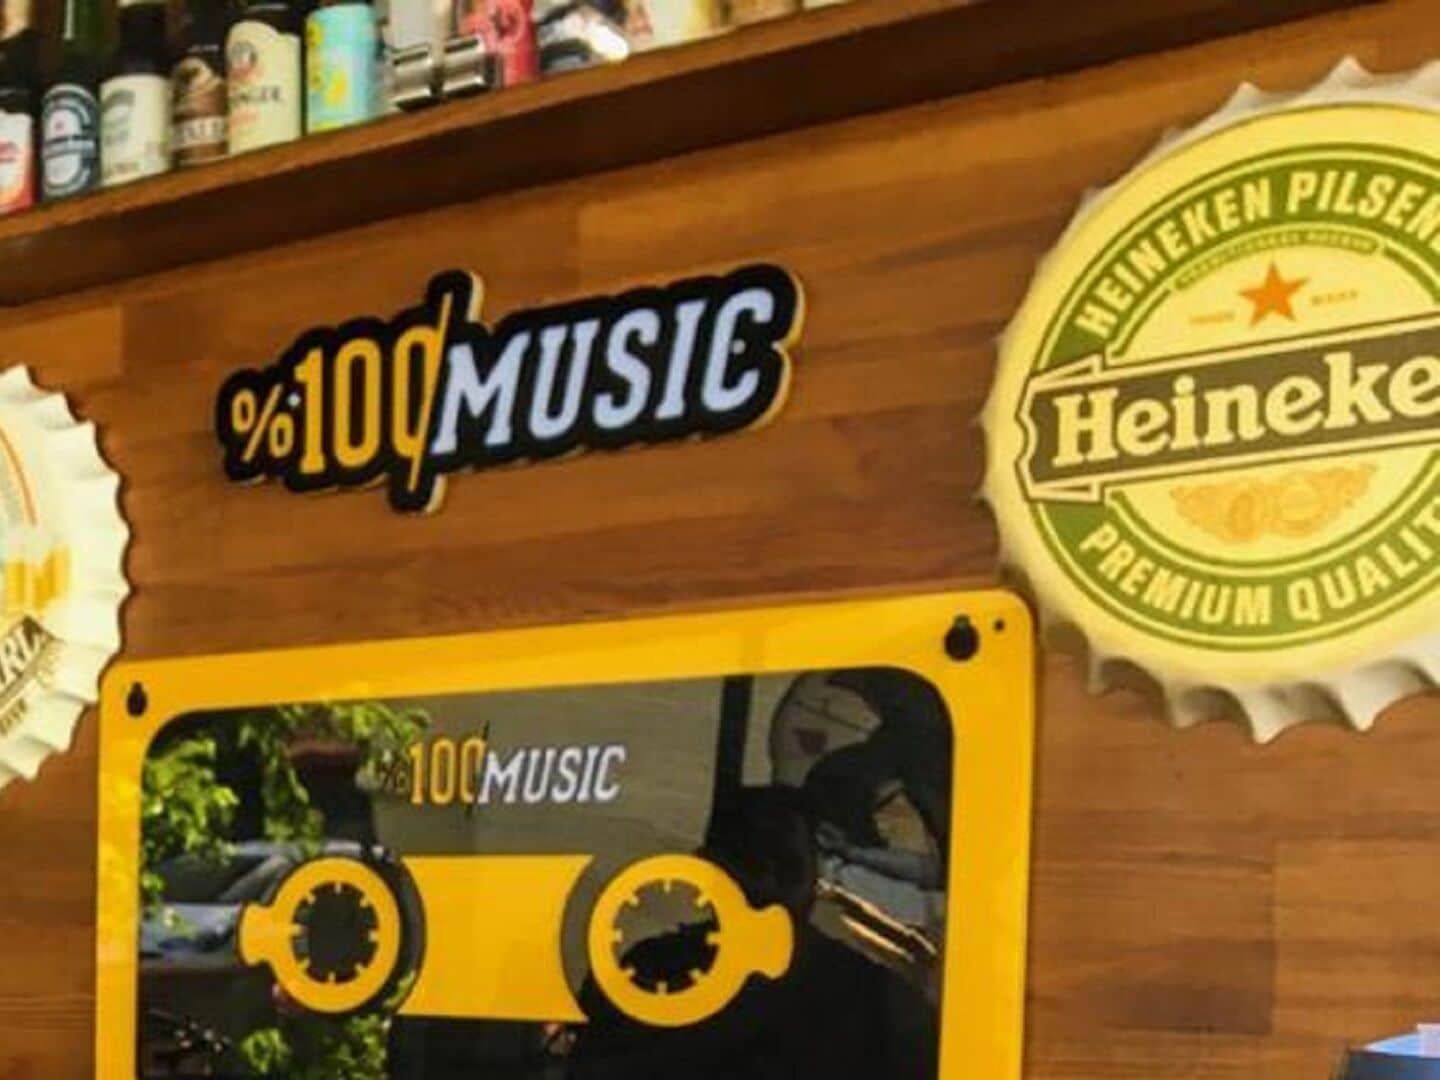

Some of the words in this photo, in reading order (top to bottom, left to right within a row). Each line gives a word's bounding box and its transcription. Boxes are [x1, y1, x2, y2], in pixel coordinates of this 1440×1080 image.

[1074, 178, 1272, 338] HEINEKEN
[1287, 170, 1440, 253] PILSEN
[1051, 351, 1440, 469] Heineke
[1079, 522, 1273, 626] PREMIUM
